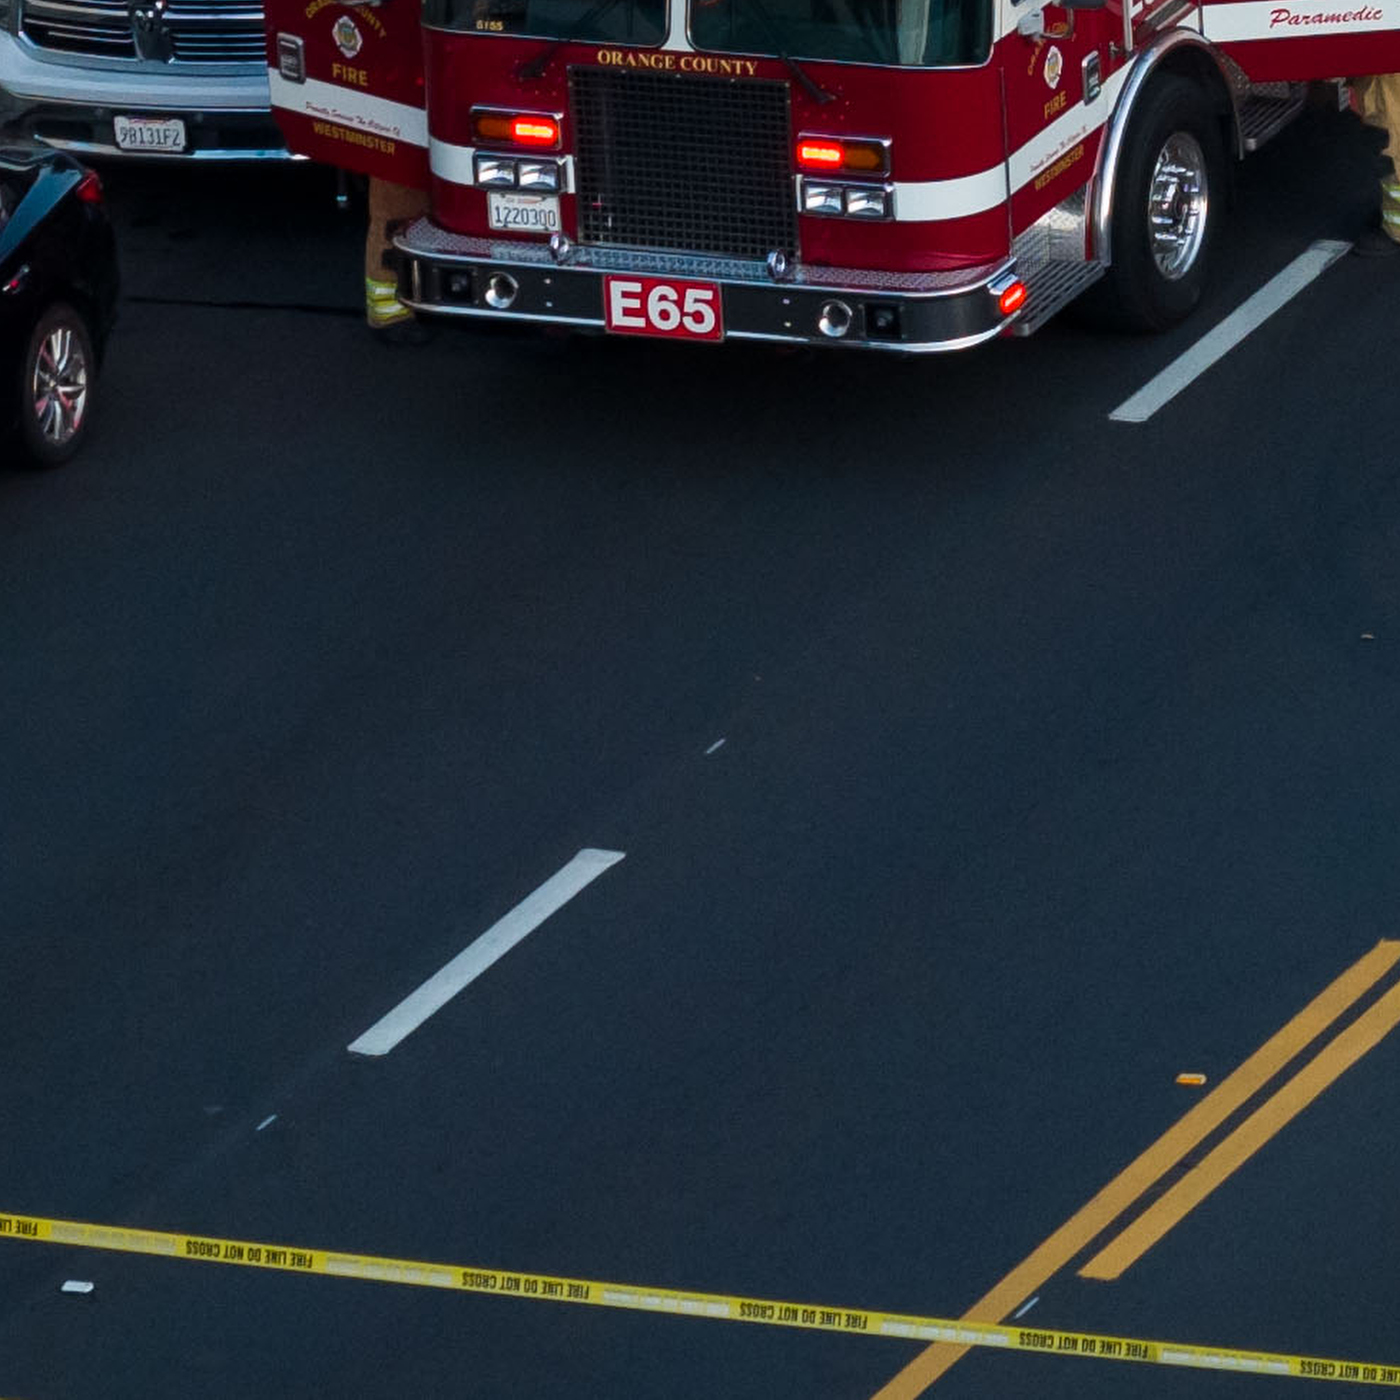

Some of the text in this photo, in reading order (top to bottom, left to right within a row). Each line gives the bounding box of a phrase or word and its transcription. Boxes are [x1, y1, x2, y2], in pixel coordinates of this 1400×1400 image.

[1269, 5, 1383, 29] Paramedic
[332, 62, 369, 87] FIRE
[598, 50, 758, 75] ORANGE COUNTY
[1043, 90, 1068, 121] FIRE
[313, 120, 396, 155] WESTMINSTER
[494, 204, 557, 228] 1220300
[610, 280, 716, 334] E65
[14, 1219, 38, 1236] FIRE
[185, 1239, 313, 1268] FIRE LINE DO NOT CROSS
[461, 1271, 590, 1299] FIRE LINE DO NOT CROSS
[739, 1302, 868, 1330] FIRE LINE DO NOT CROSS
[1018, 1332, 1149, 1357] FIRE LINE DO NOT CROSS
[1299, 1361, 1335, 1375] CROSS
[1338, 1365, 1359, 1378] NOT
[1362, 1368, 1377, 1379] DO
